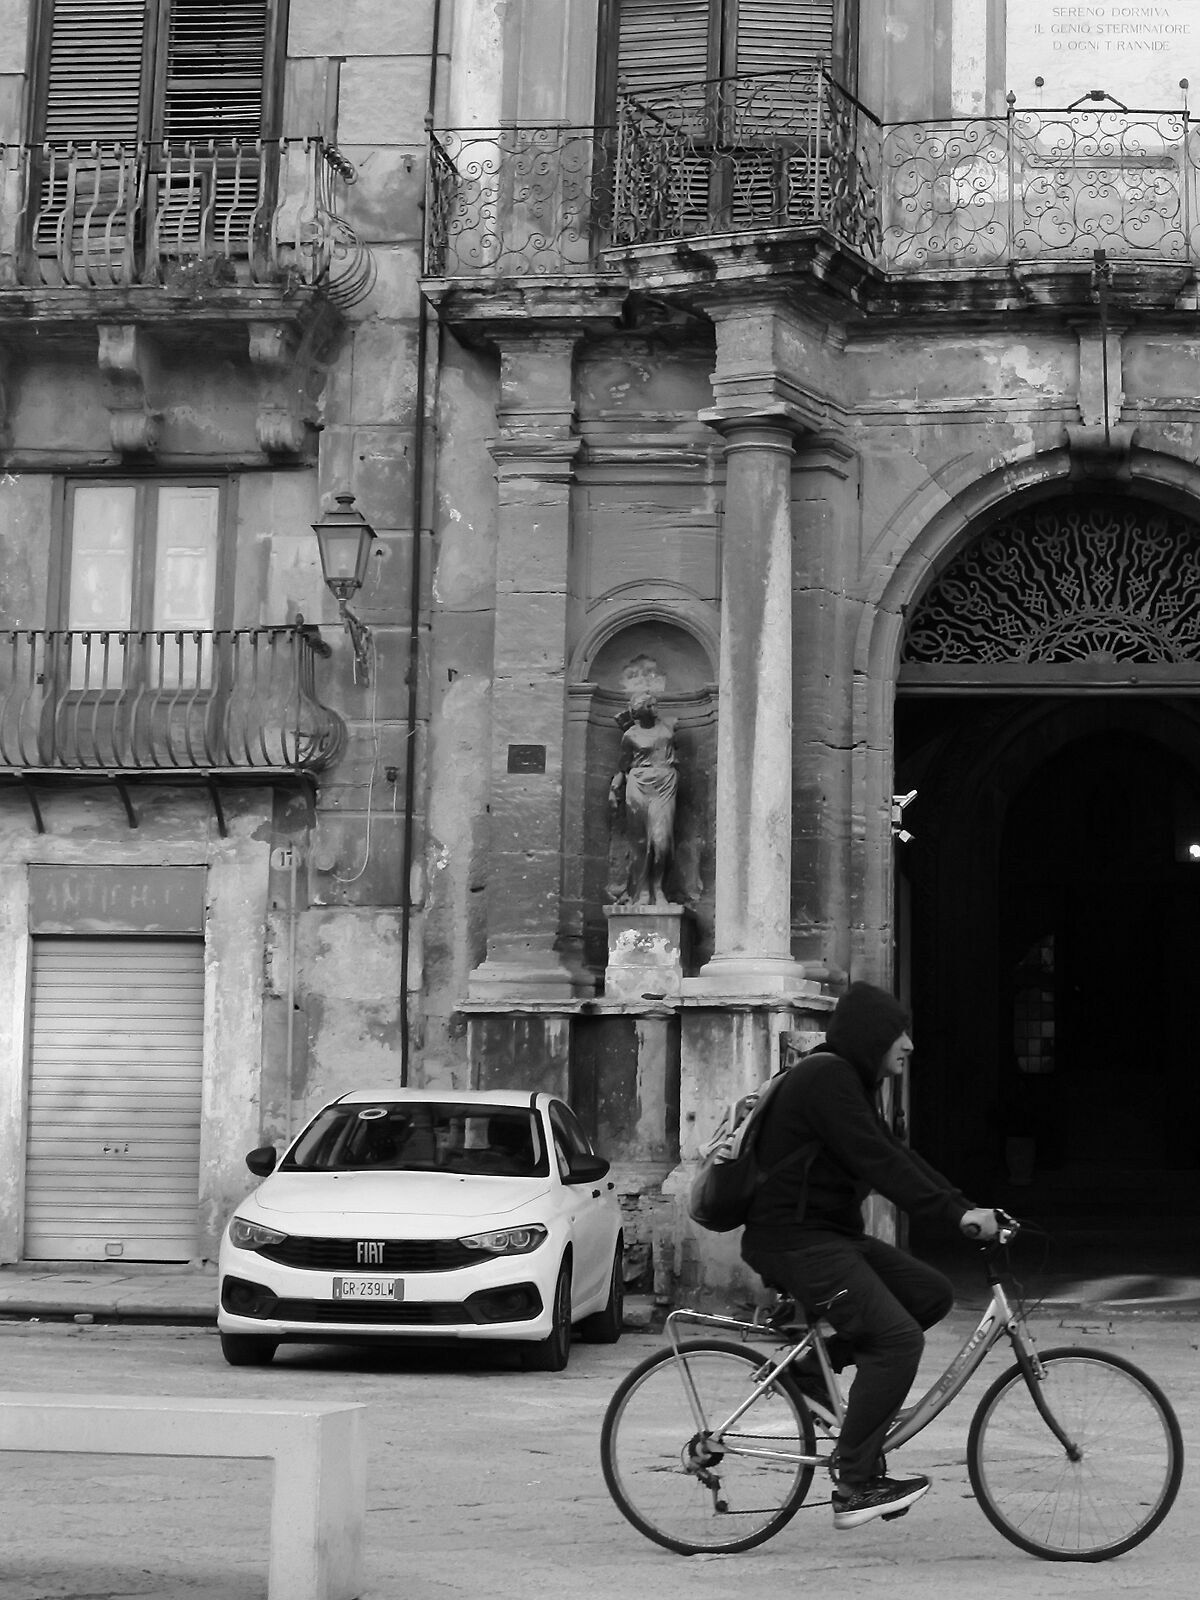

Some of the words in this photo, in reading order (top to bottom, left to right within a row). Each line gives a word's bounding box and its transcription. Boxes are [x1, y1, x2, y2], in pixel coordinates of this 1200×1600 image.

[1052, 7, 1105, 17] SERENO
[1111, 7, 1170, 17] DORMIVA
[1051, 23, 1091, 34] GENIO
[1096, 23, 1191, 34] STERMINATORE
[357, 1241, 385, 1263] FIAT
